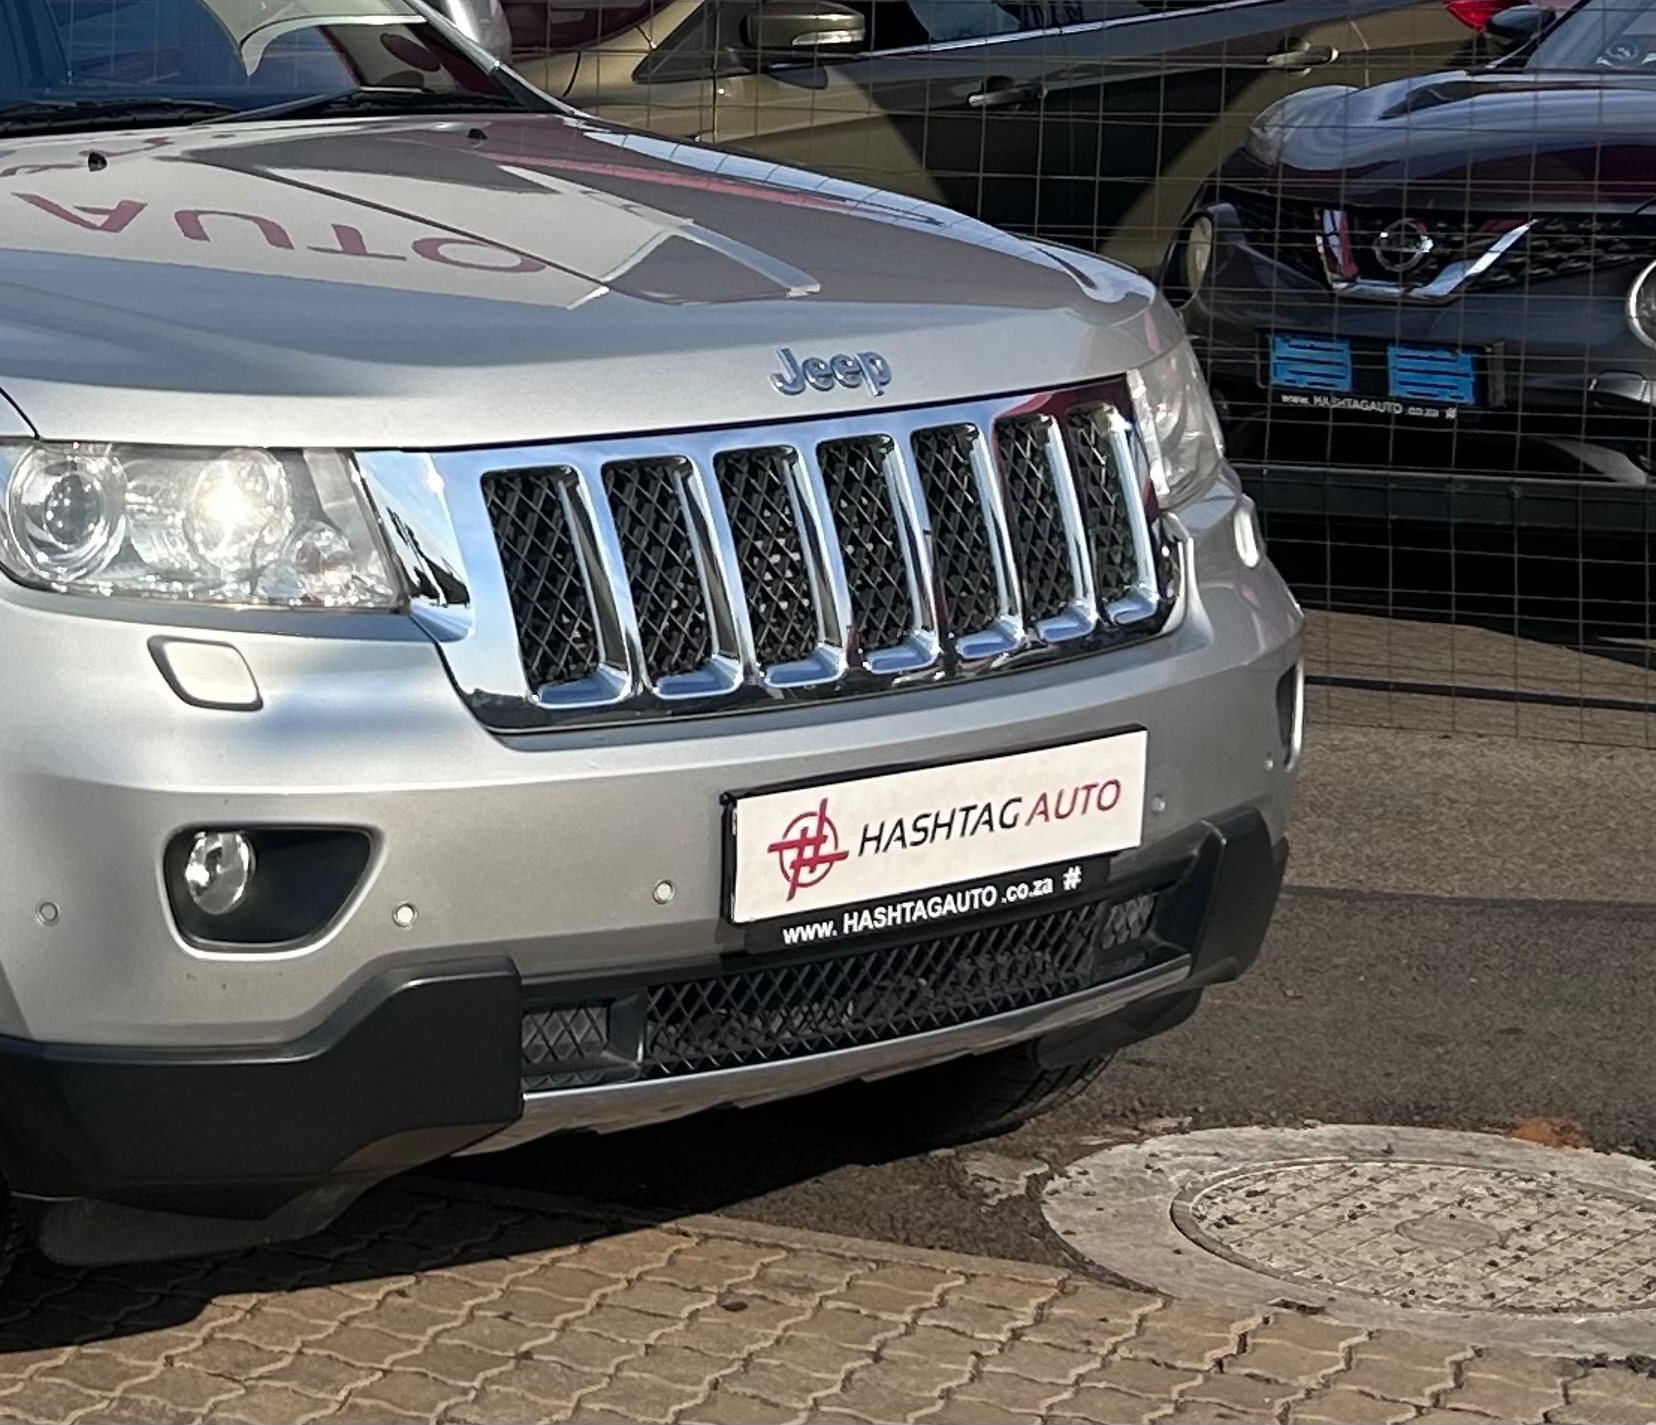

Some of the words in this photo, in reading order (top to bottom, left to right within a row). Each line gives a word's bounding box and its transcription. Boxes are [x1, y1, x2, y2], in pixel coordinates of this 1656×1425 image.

[768, 345, 892, 397] Jeep
[858, 797, 1022, 857] HASHTAG
[1025, 778, 1121, 827] AUTO
[783, 920, 838, 945] www.
